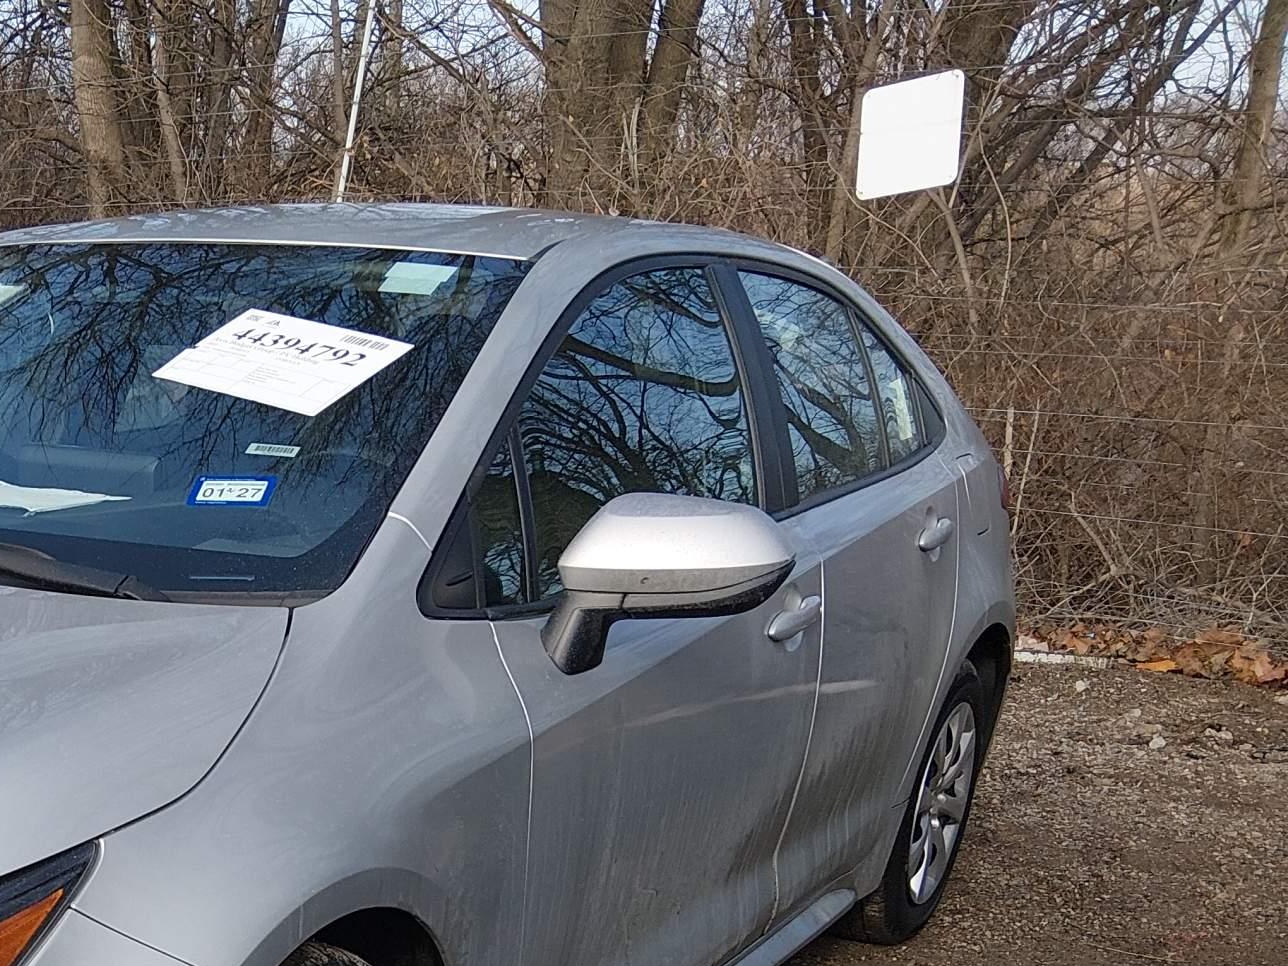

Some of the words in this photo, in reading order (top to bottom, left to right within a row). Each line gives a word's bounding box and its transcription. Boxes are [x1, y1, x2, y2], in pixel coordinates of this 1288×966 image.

[233, 328, 367, 367] 44394792
[202, 487, 225, 498] 01
[235, 487, 263, 498] 27
